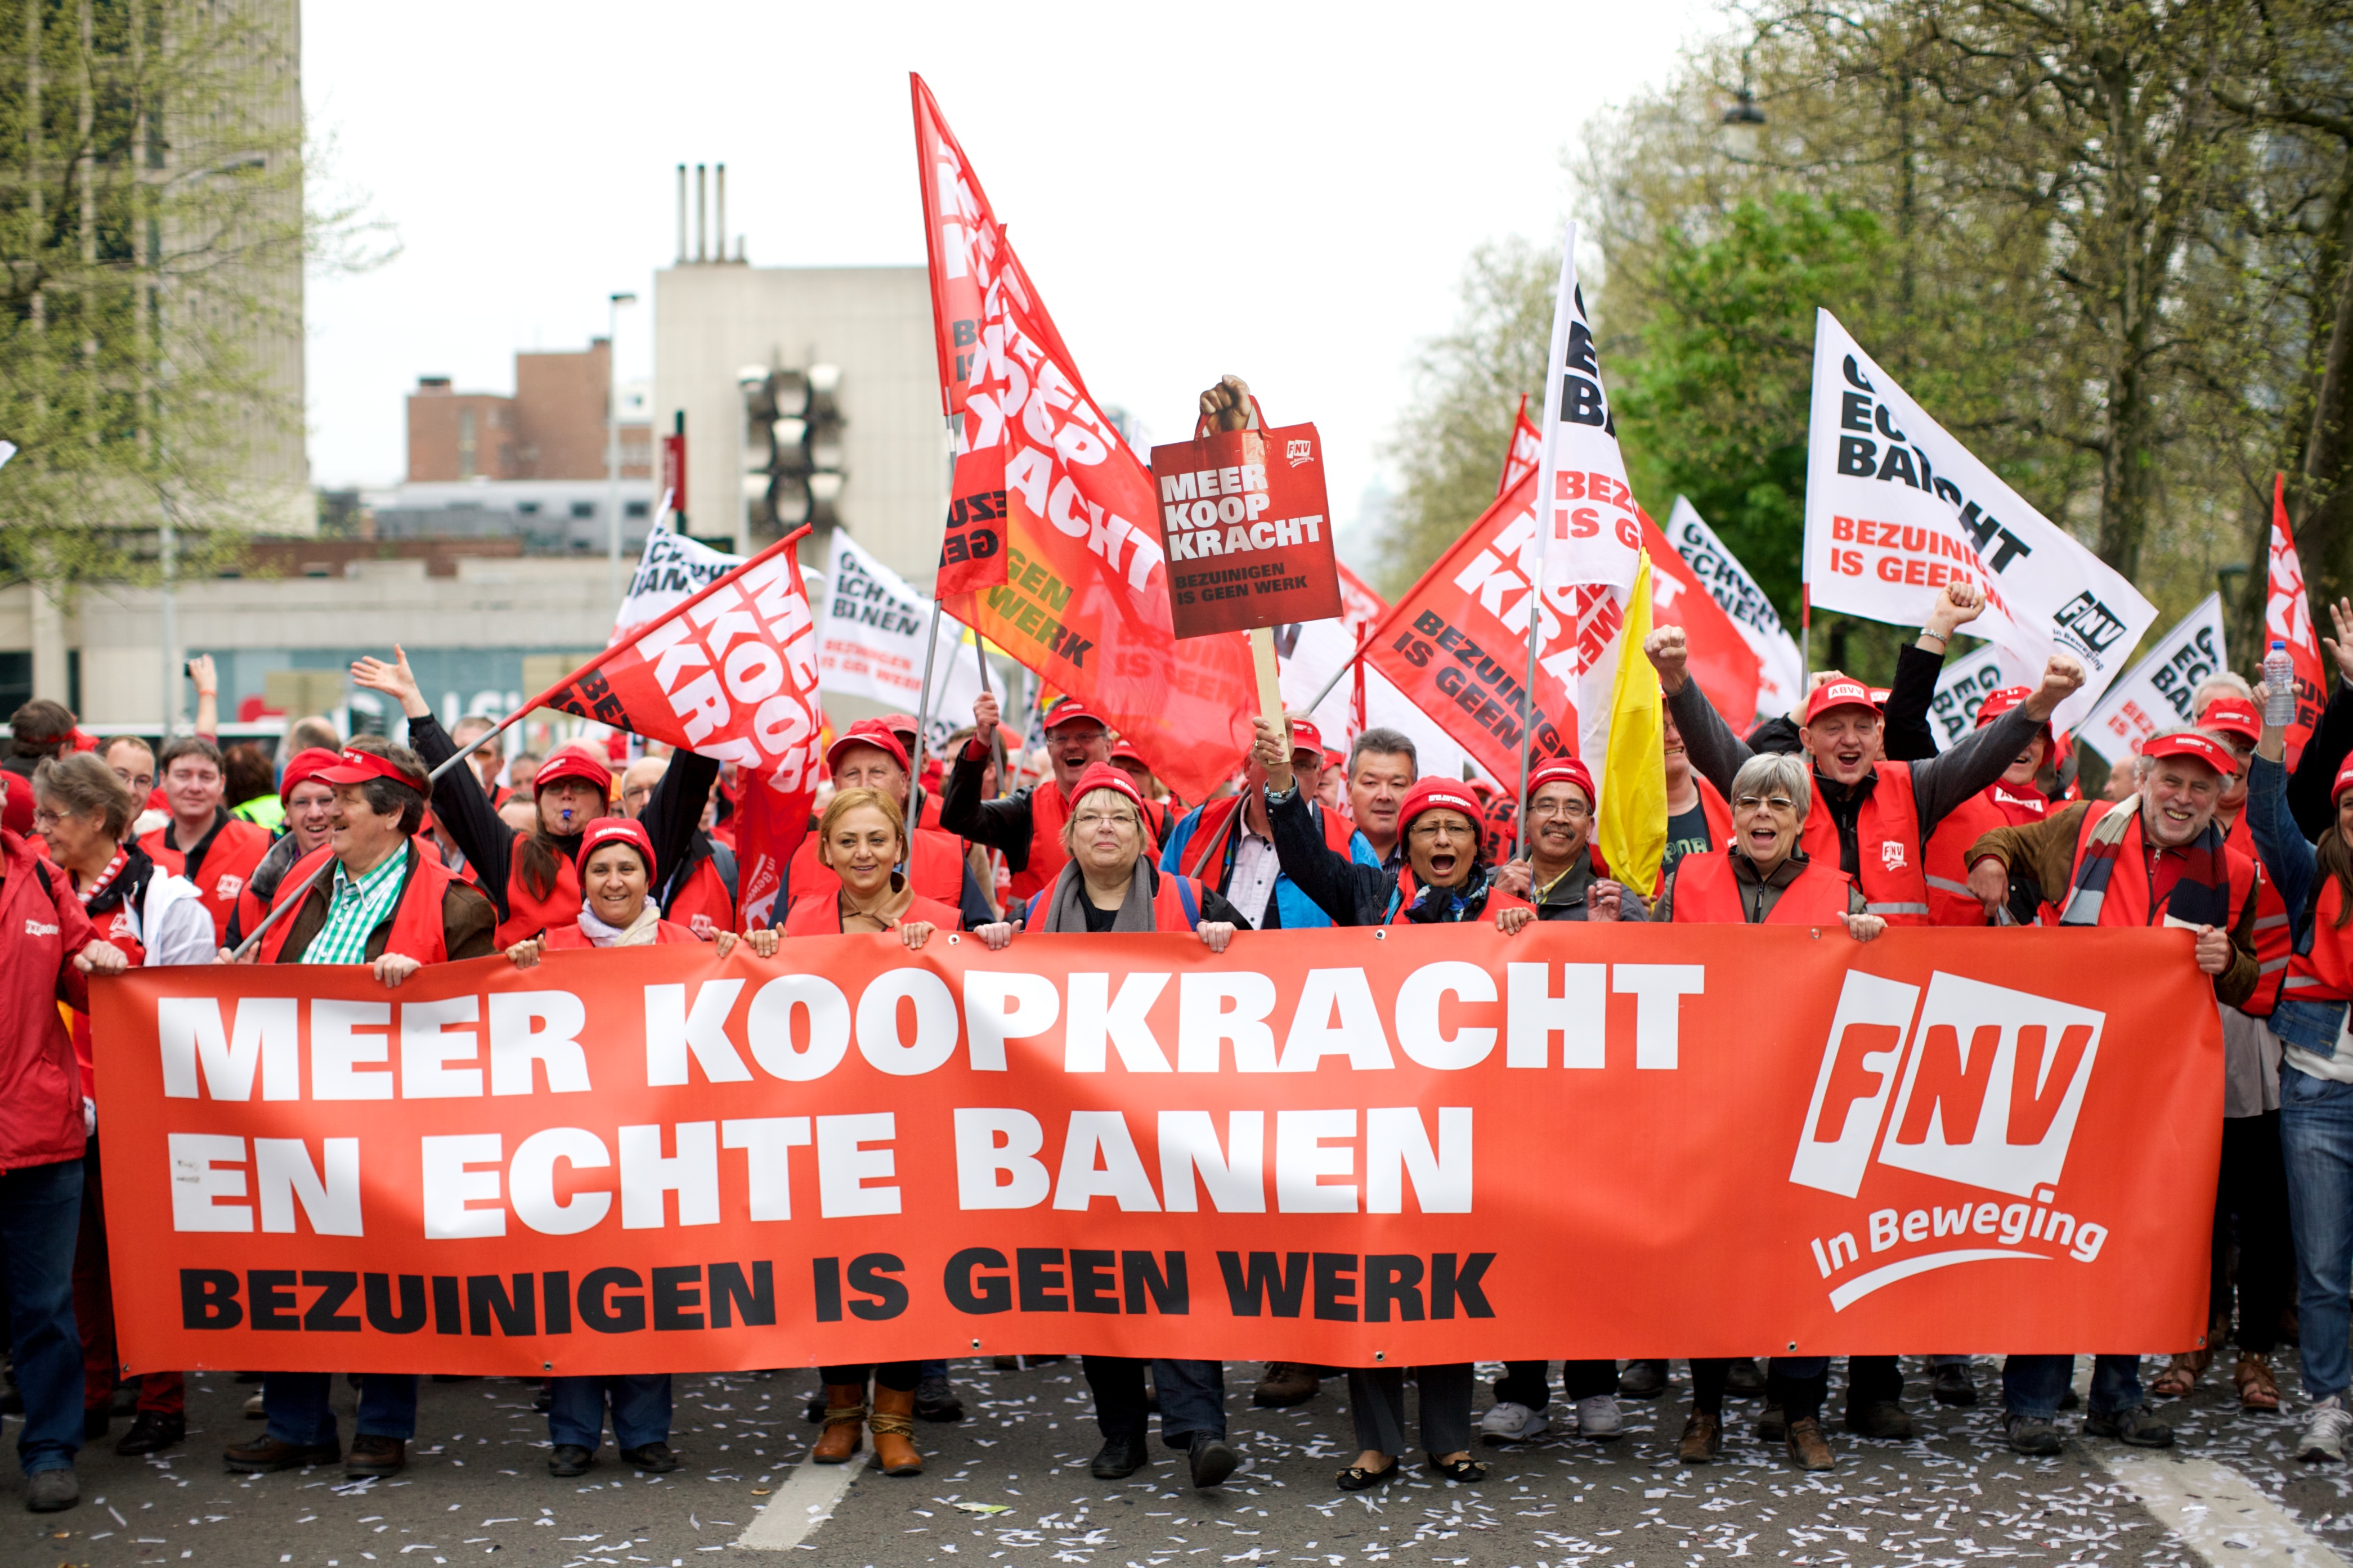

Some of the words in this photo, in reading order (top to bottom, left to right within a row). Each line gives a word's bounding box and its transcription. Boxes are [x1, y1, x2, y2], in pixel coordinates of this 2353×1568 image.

[1160, 463, 1269, 503] MEER
[1164, 493, 1270, 532] KOOP
[1555, 508, 1599, 540] IS
[1168, 514, 1324, 562] KRACHT
[1175, 561, 1285, 590] BEZUINIGEN
[1830, 548, 1865, 577] IS
[1177, 590, 1195, 605] IS
[1201, 583, 1249, 602] GEEN
[1255, 575, 1308, 595] WERK
[1392, 631, 1435, 668] IS
[1435, 666, 1523, 751] GEEN
[1831, 686, 1861, 696] ABVV
[158, 990, 591, 1102] MEER
[644, 961, 1704, 1087] KOOPKRACHT
[1812, 1022, 2095, 1147] FNV
[168, 1133, 364, 1237] EN
[422, 1112, 902, 1240] ECHTE
[953, 1106, 1473, 1214] BANEN
[1810, 1231, 1859, 1279] In
[1868, 1188, 2109, 1263] Beweging
[180, 1260, 776, 1337] BEZUINIGEN
[813, 1252, 909, 1323] IS
[943, 1247, 1190, 1317] GEEN
[1216, 1251, 1498, 1323] WERK
